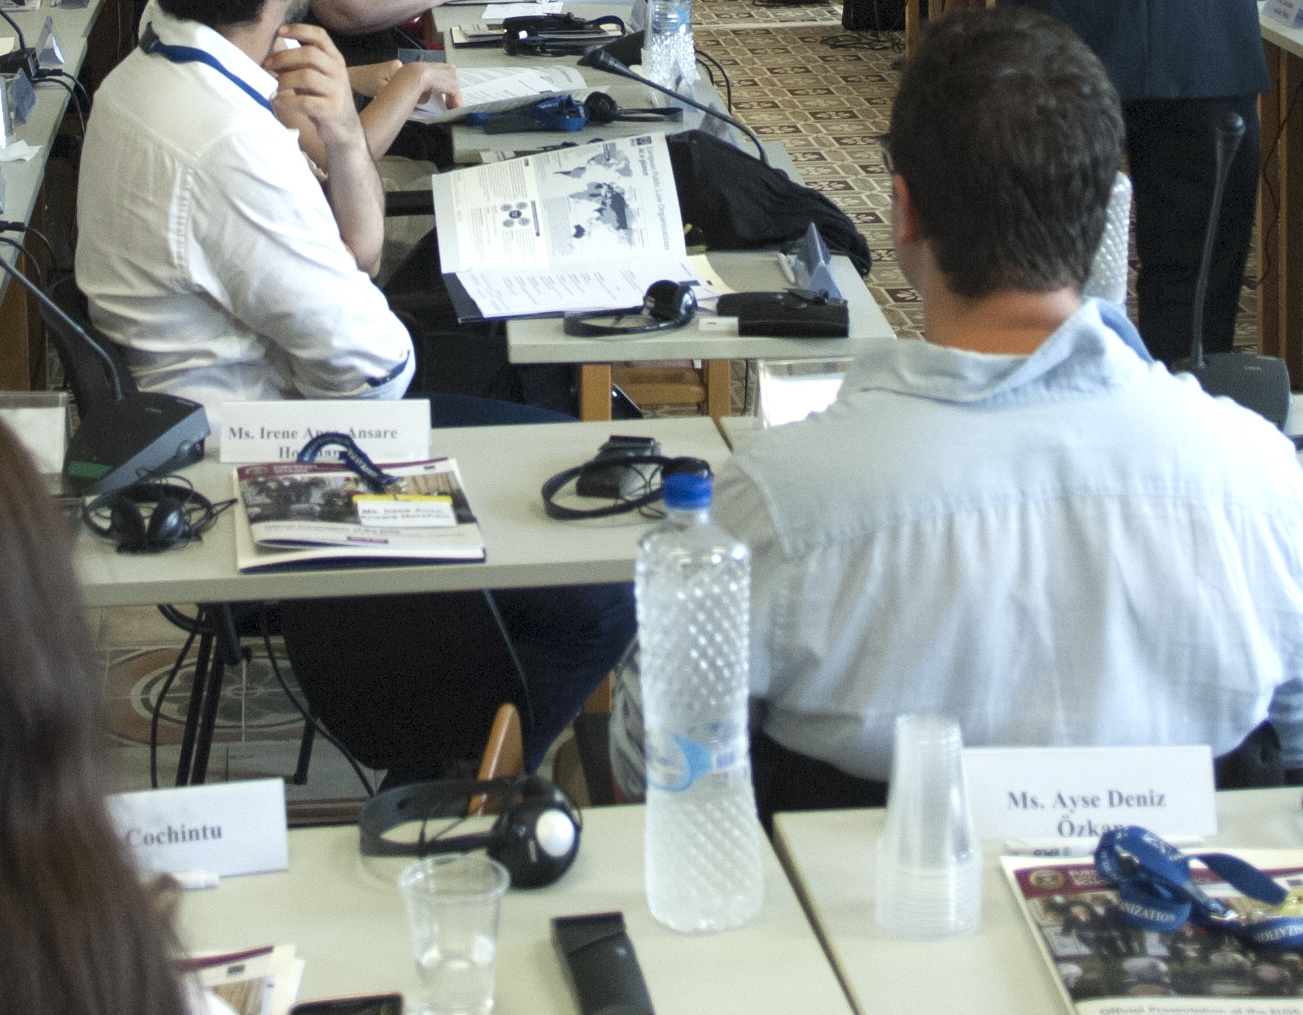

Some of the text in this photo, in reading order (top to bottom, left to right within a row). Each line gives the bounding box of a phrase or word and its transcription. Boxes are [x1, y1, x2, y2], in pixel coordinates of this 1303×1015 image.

[228, 427, 255, 440] Ms.
[260, 427, 298, 440] Irene
[1007, 789, 1167, 813] Ms. Ayse Deniz
[125, 823, 223, 848] Cochintu
